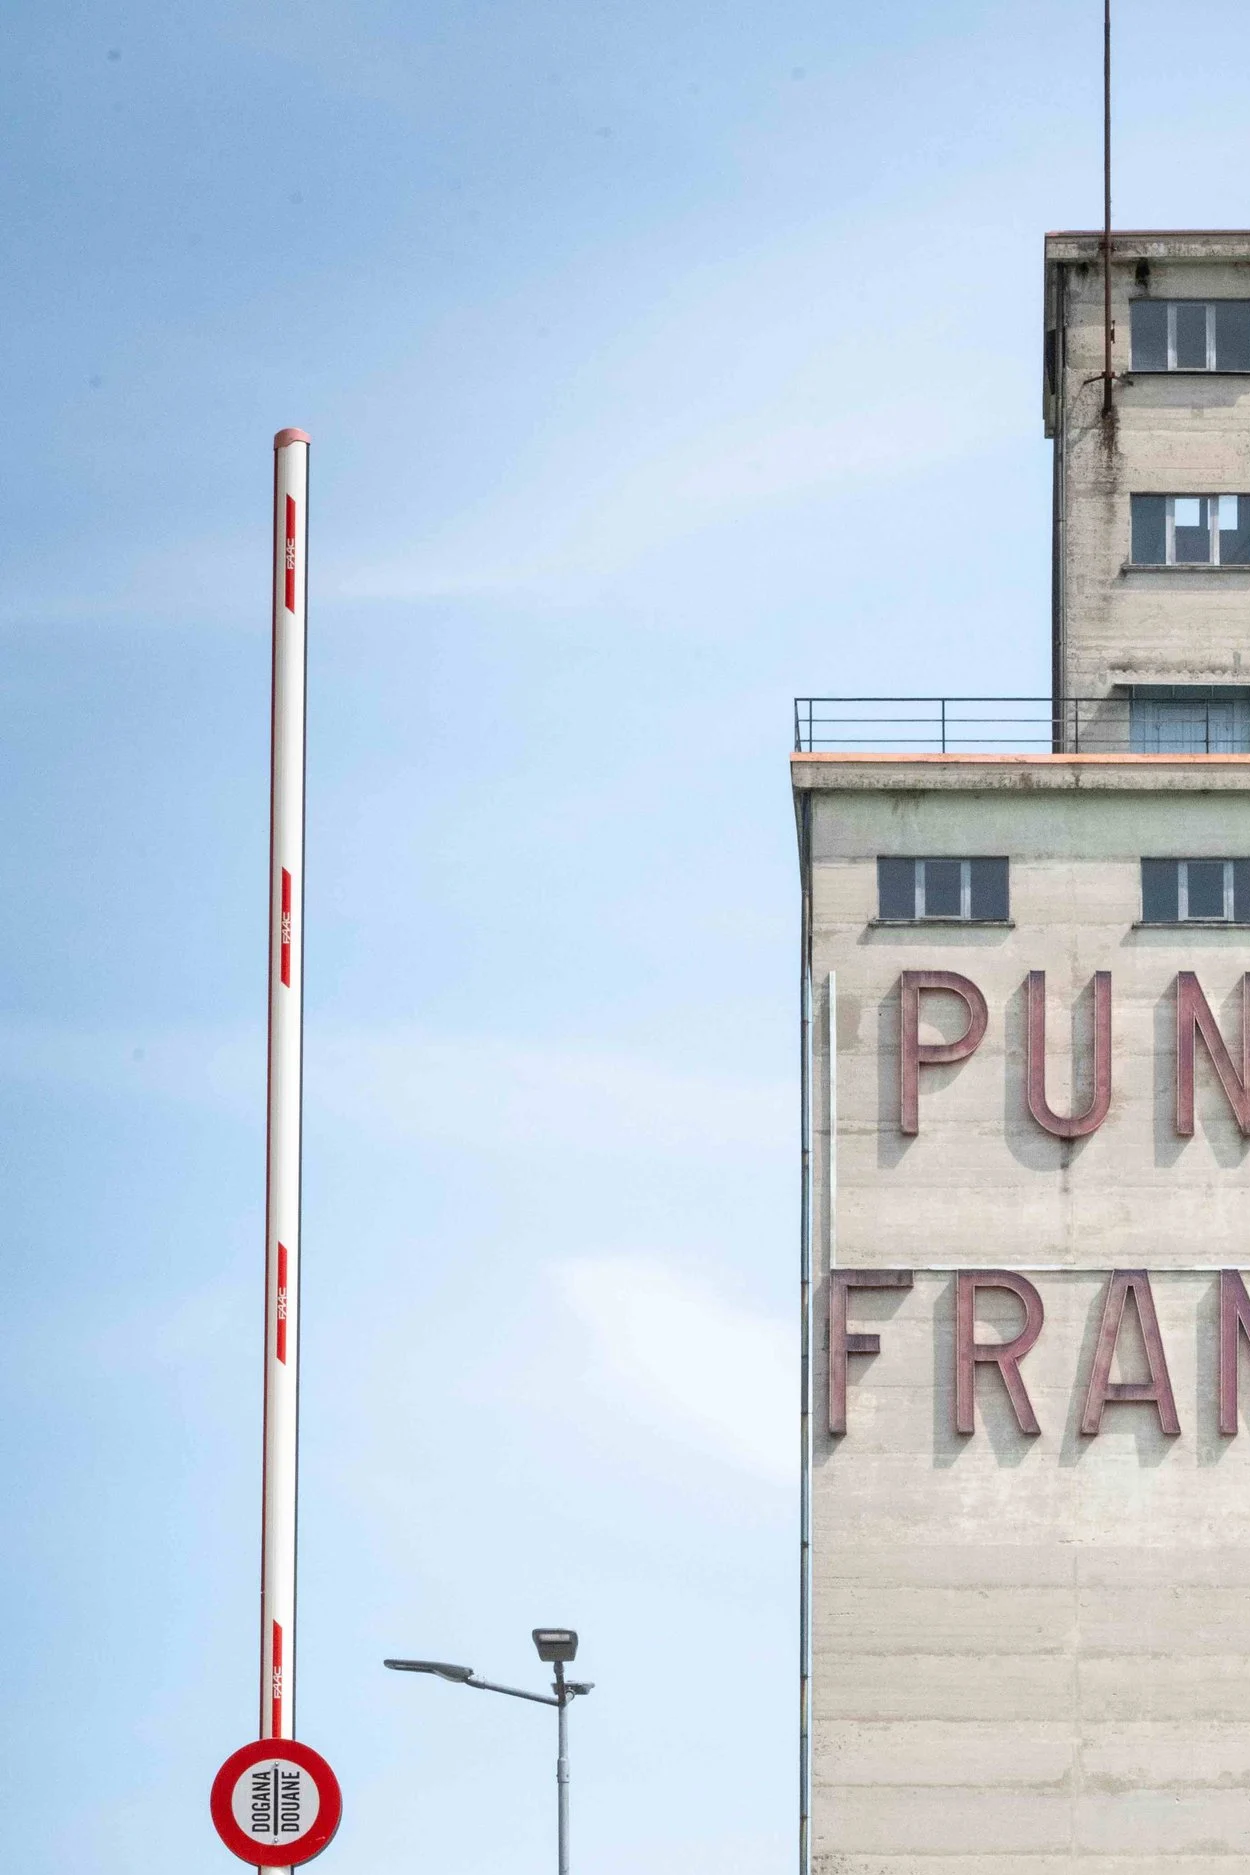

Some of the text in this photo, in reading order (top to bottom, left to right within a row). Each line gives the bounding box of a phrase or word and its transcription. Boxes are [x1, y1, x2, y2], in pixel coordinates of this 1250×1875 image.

[287, 538, 295, 570] FAAC
[282, 912, 290, 944] FAAC
[278, 1288, 286, 1320] FAAC
[274, 1667, 282, 1699] FAAC
[252, 1771, 271, 1832] DOGANA
[281, 1771, 300, 1832] DOUANE
